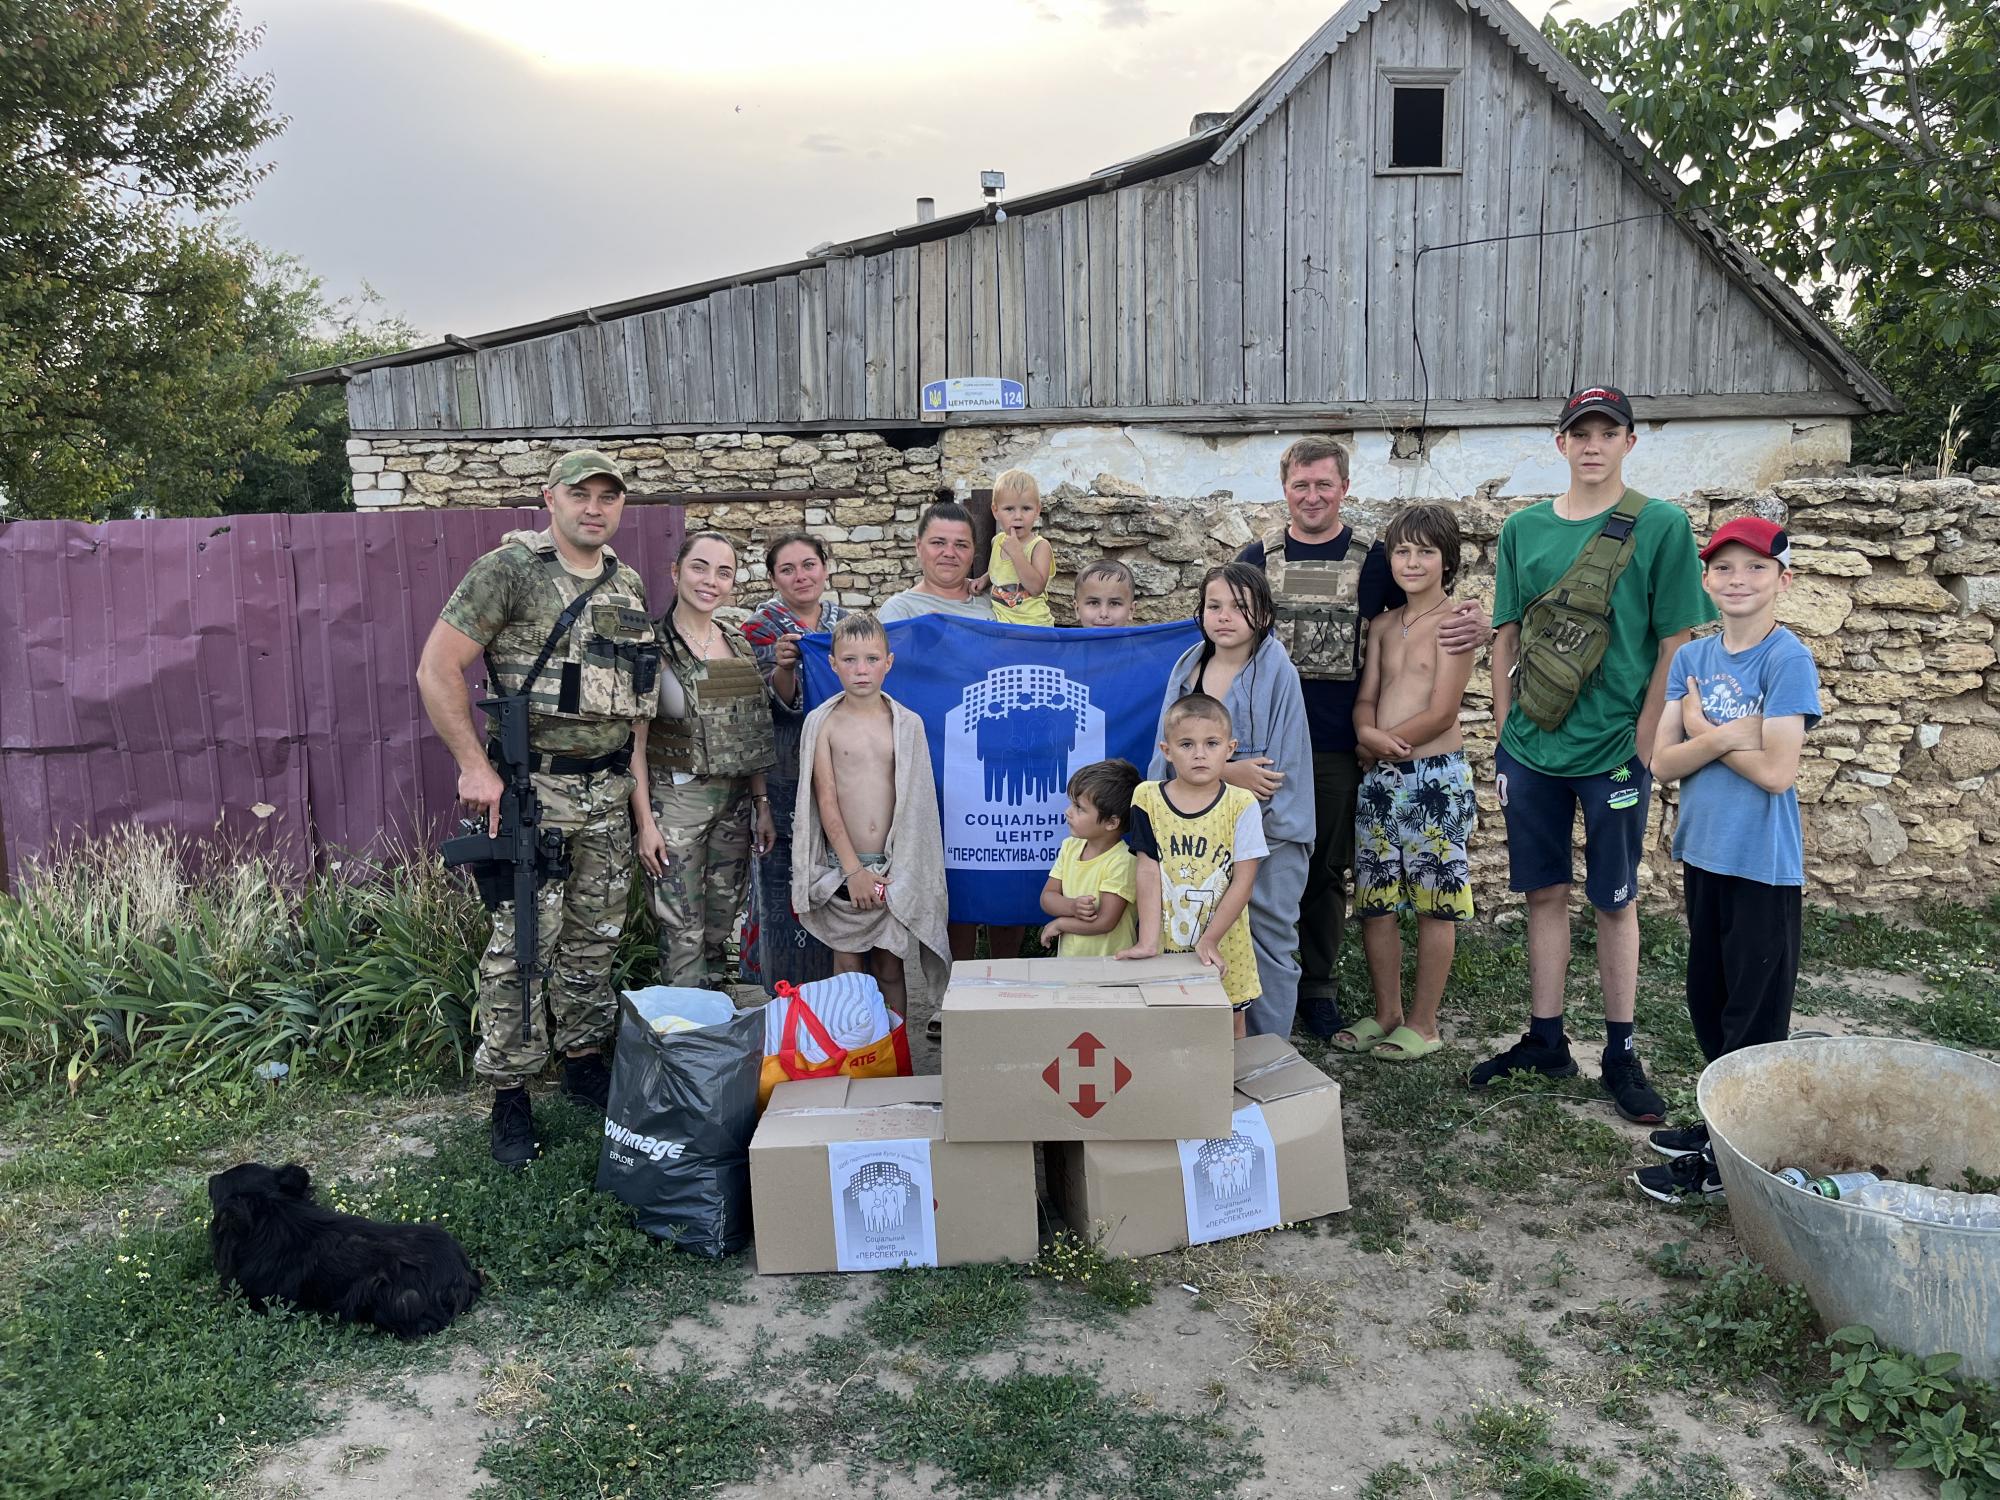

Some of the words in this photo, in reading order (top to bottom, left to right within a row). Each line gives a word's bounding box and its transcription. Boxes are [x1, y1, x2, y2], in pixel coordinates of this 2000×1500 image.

[948, 398, 1000, 407] ЦЕНТРАЛЬНА
[1004, 391, 1022, 406] 124
[996, 830, 1054, 843] ЦЕНТР
[1170, 834, 1208, 858] AND
[609, 1150, 635, 1167] EXPLORE
[864, 1235, 906, 1244] Соціальний
[875, 1244, 896, 1252] центр
